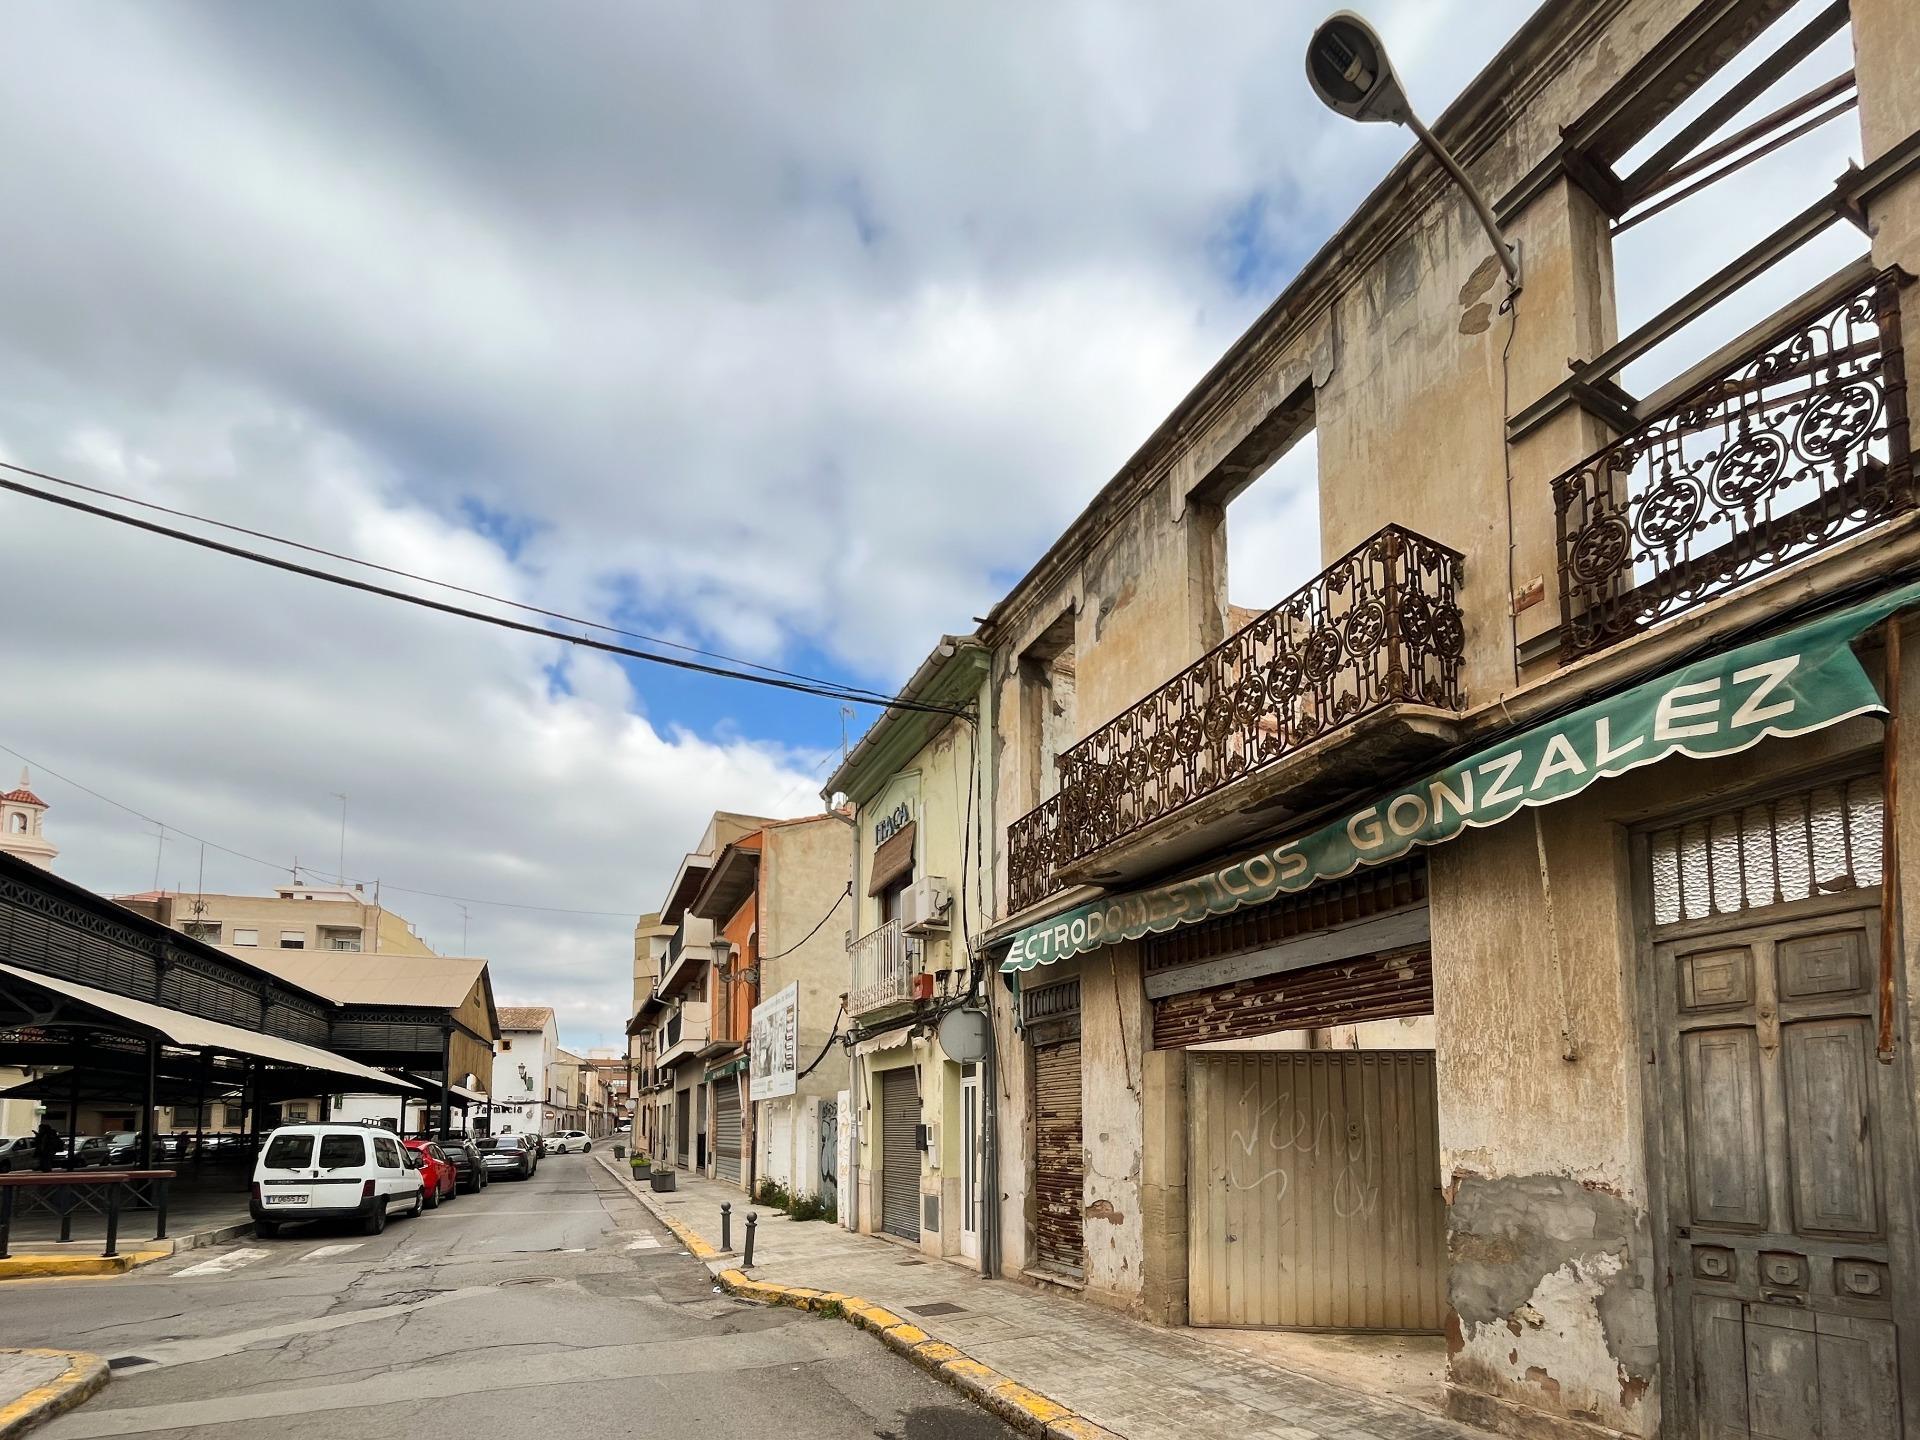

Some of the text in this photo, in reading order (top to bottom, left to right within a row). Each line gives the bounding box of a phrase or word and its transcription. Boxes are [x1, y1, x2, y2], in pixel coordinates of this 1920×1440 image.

[1346, 654, 1801, 851] GONZALEZ
[875, 802, 909, 846] ITACA
[475, 1105, 523, 1115] famacia
